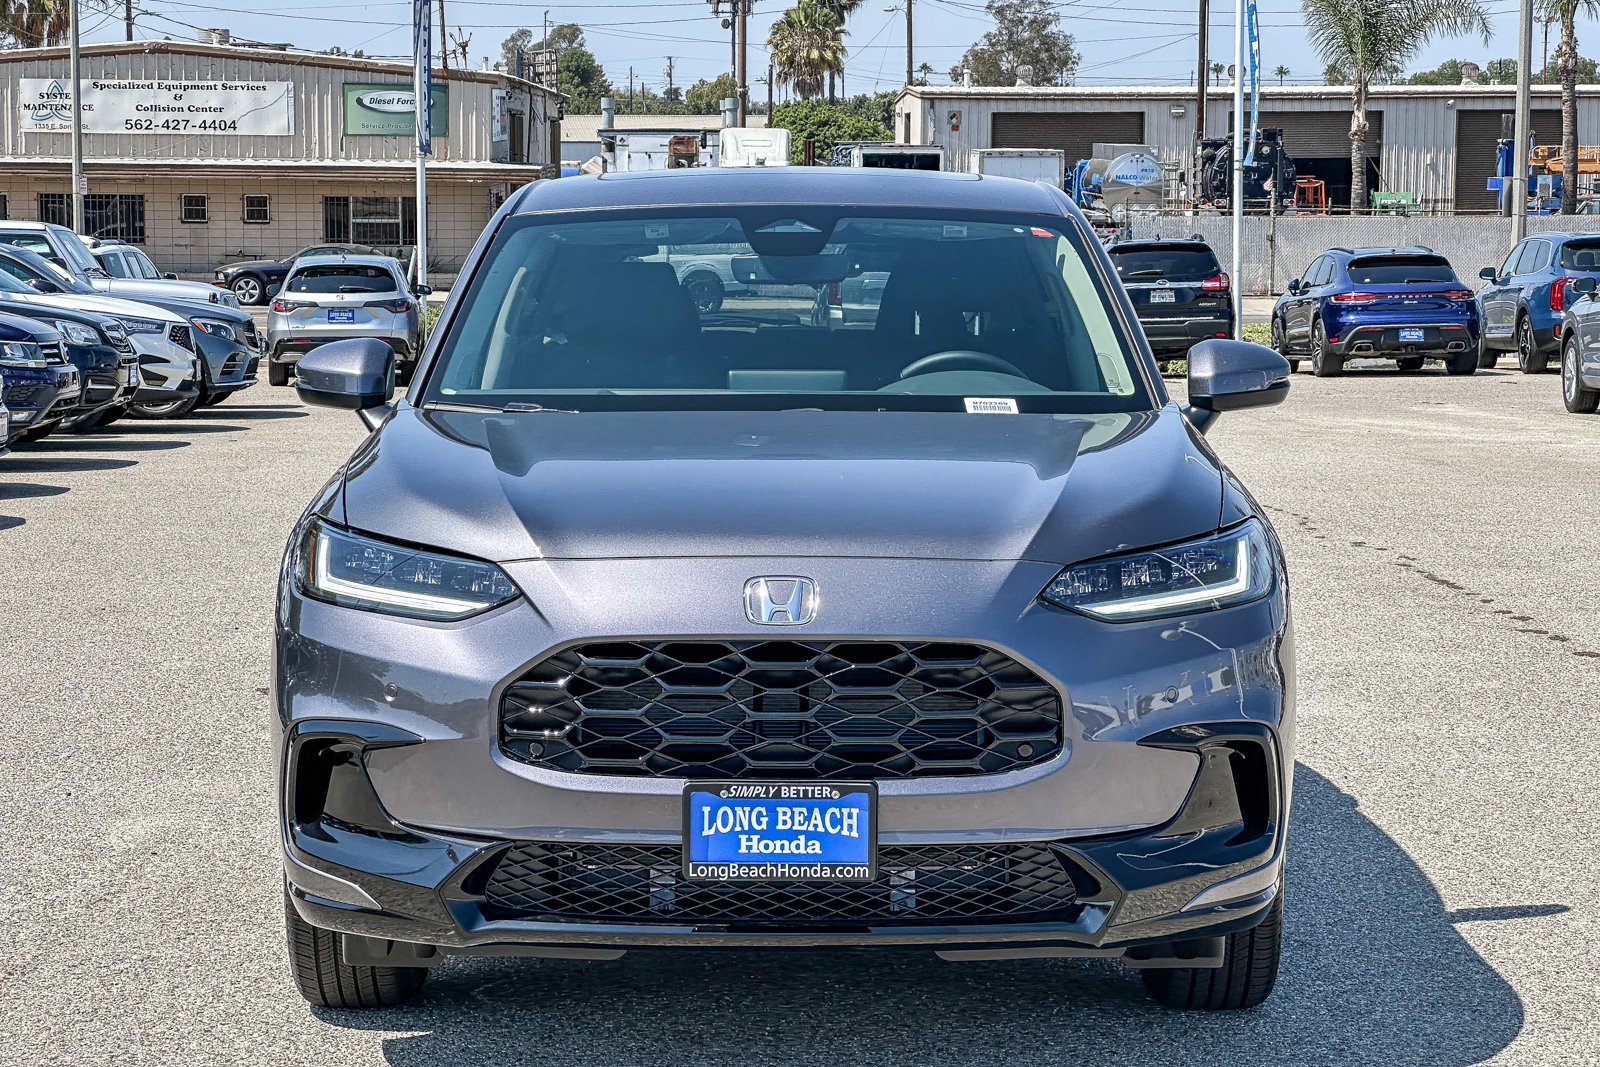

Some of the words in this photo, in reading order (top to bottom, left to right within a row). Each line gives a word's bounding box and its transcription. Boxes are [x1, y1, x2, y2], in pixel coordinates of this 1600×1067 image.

[92, 81, 154, 91] Specialized
[157, 83, 217, 92] Equipment
[220, 83, 267, 92] Services
[38, 92, 72, 100] SYSTE
[369, 97, 395, 105] Diesel
[396, 97, 415, 105] Forc
[23, 103, 95, 111] MAINTENACE
[135, 104, 185, 113] Collision
[187, 105, 225, 113] Center
[124, 118, 238, 132] 562-427-4404
[728, 785, 778, 798] SIMPLY
[781, 786, 831, 798] BETTER
[702, 805, 769, 837] LONG
[776, 807, 859, 838] BEACH
[738, 834, 822, 855] Honda
[689, 862, 869, 881] LongBeachHonda.com
